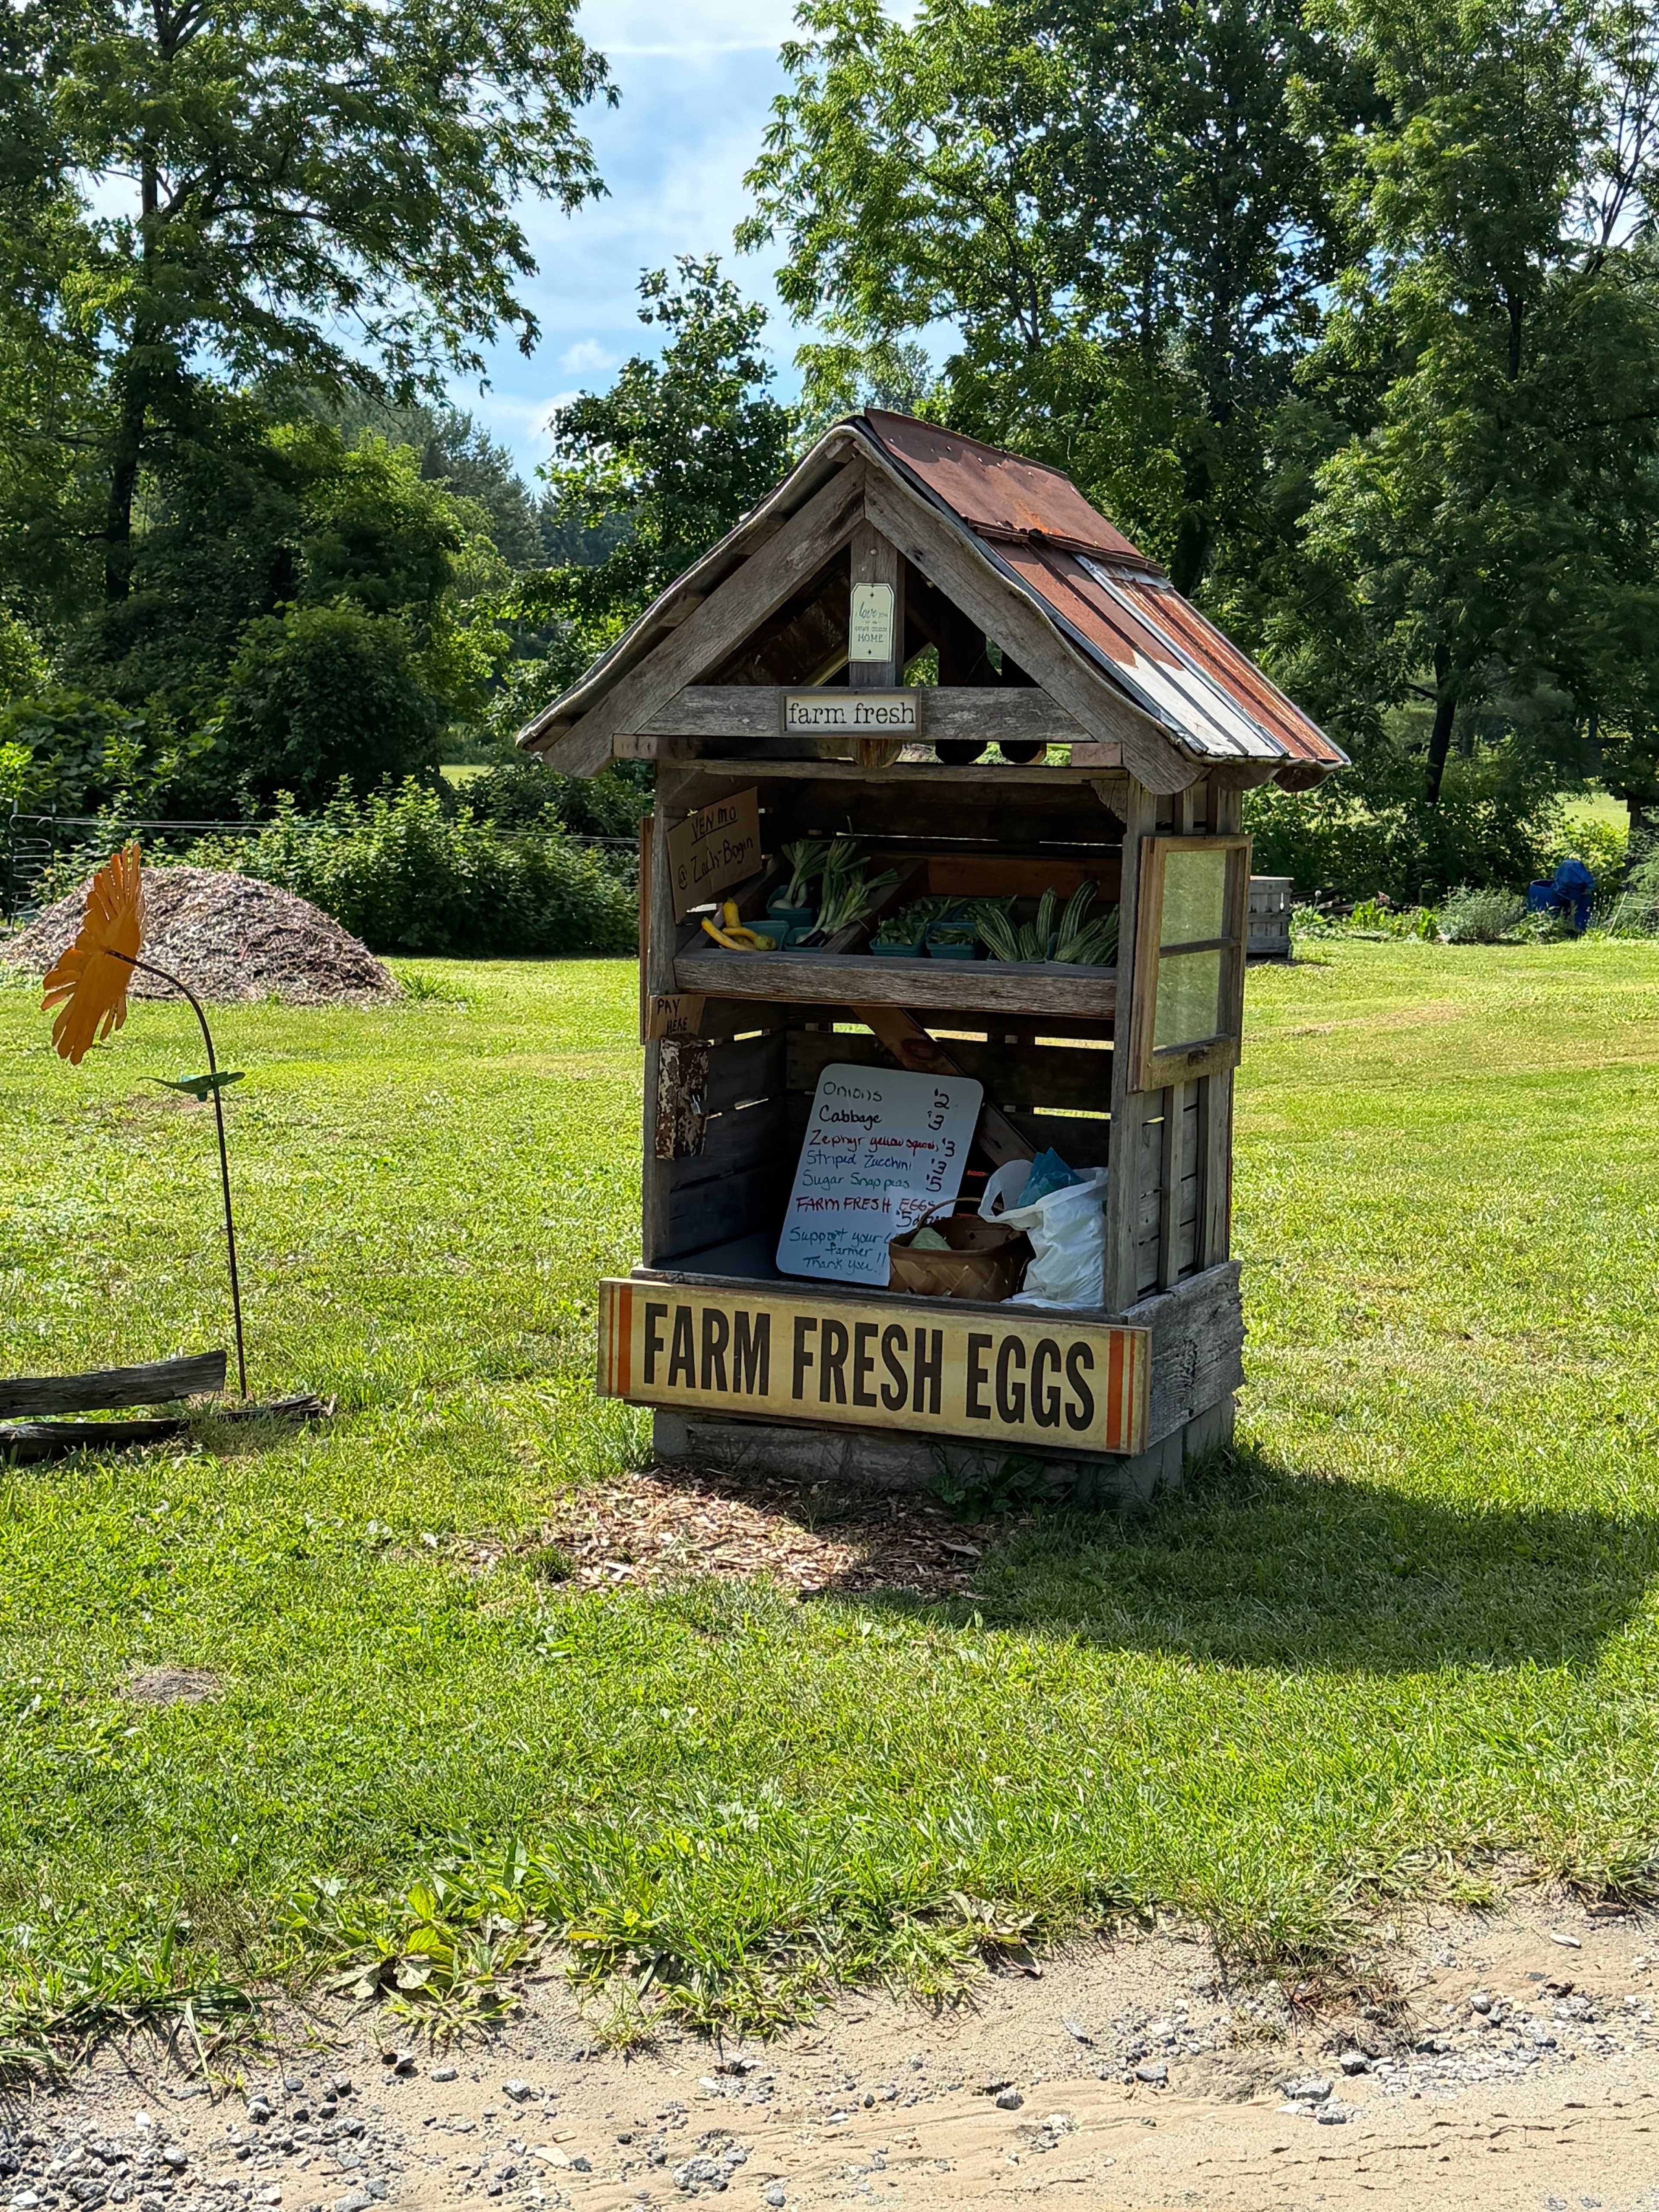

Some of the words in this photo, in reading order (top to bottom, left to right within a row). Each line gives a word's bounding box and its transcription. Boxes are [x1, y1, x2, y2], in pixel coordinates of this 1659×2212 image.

[858, 633, 884, 642] HOME
[788, 702, 847, 724] farm
[853, 702, 915, 724] fresh
[678, 864, 688, 890] @
[657, 998, 681, 1018] PAY
[666, 1017, 688, 1036] HERE
[823, 1081, 882, 1102] Onions
[819, 1105, 882, 1131] Cabbage
[809, 1129, 866, 1152] Zephyr
[807, 1150, 857, 1168] Striped
[864, 1154, 912, 1171] Zucchini
[802, 1169, 844, 1191] Sugar
[843, 1196, 892, 1214] FRESH
[789, 1226, 848, 1244] Support
[852, 1231, 883, 1248] your
[825, 1241, 873, 1258] farmer
[803, 1255, 842, 1270] Thank
[643, 1302, 772, 1397] FARM
[791, 1315, 943, 1416] FRESH
[964, 1332, 1095, 1433] EGGS
